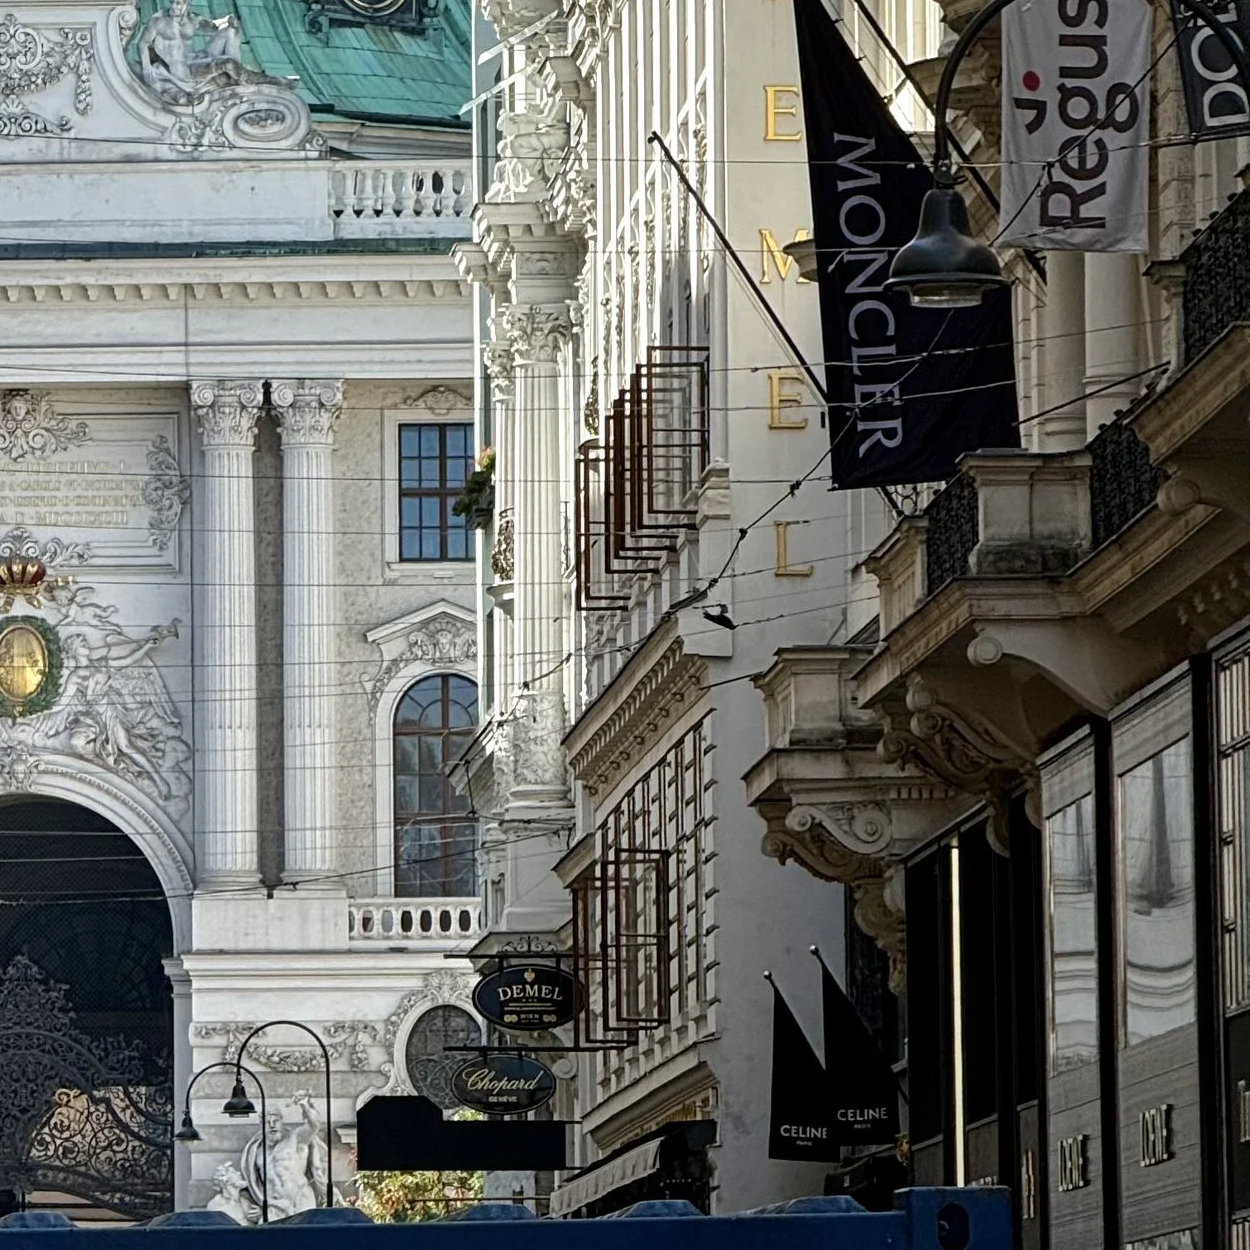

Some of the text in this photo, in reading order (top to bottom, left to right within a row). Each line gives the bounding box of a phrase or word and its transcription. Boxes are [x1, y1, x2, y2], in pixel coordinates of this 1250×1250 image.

[828, 131, 904, 459] MONCLER
[497, 984, 563, 1001] DEMEL
[462, 1067, 545, 1095] Chopard
[837, 1107, 889, 1121] CELINE
[780, 1124, 828, 1139] CELINE
